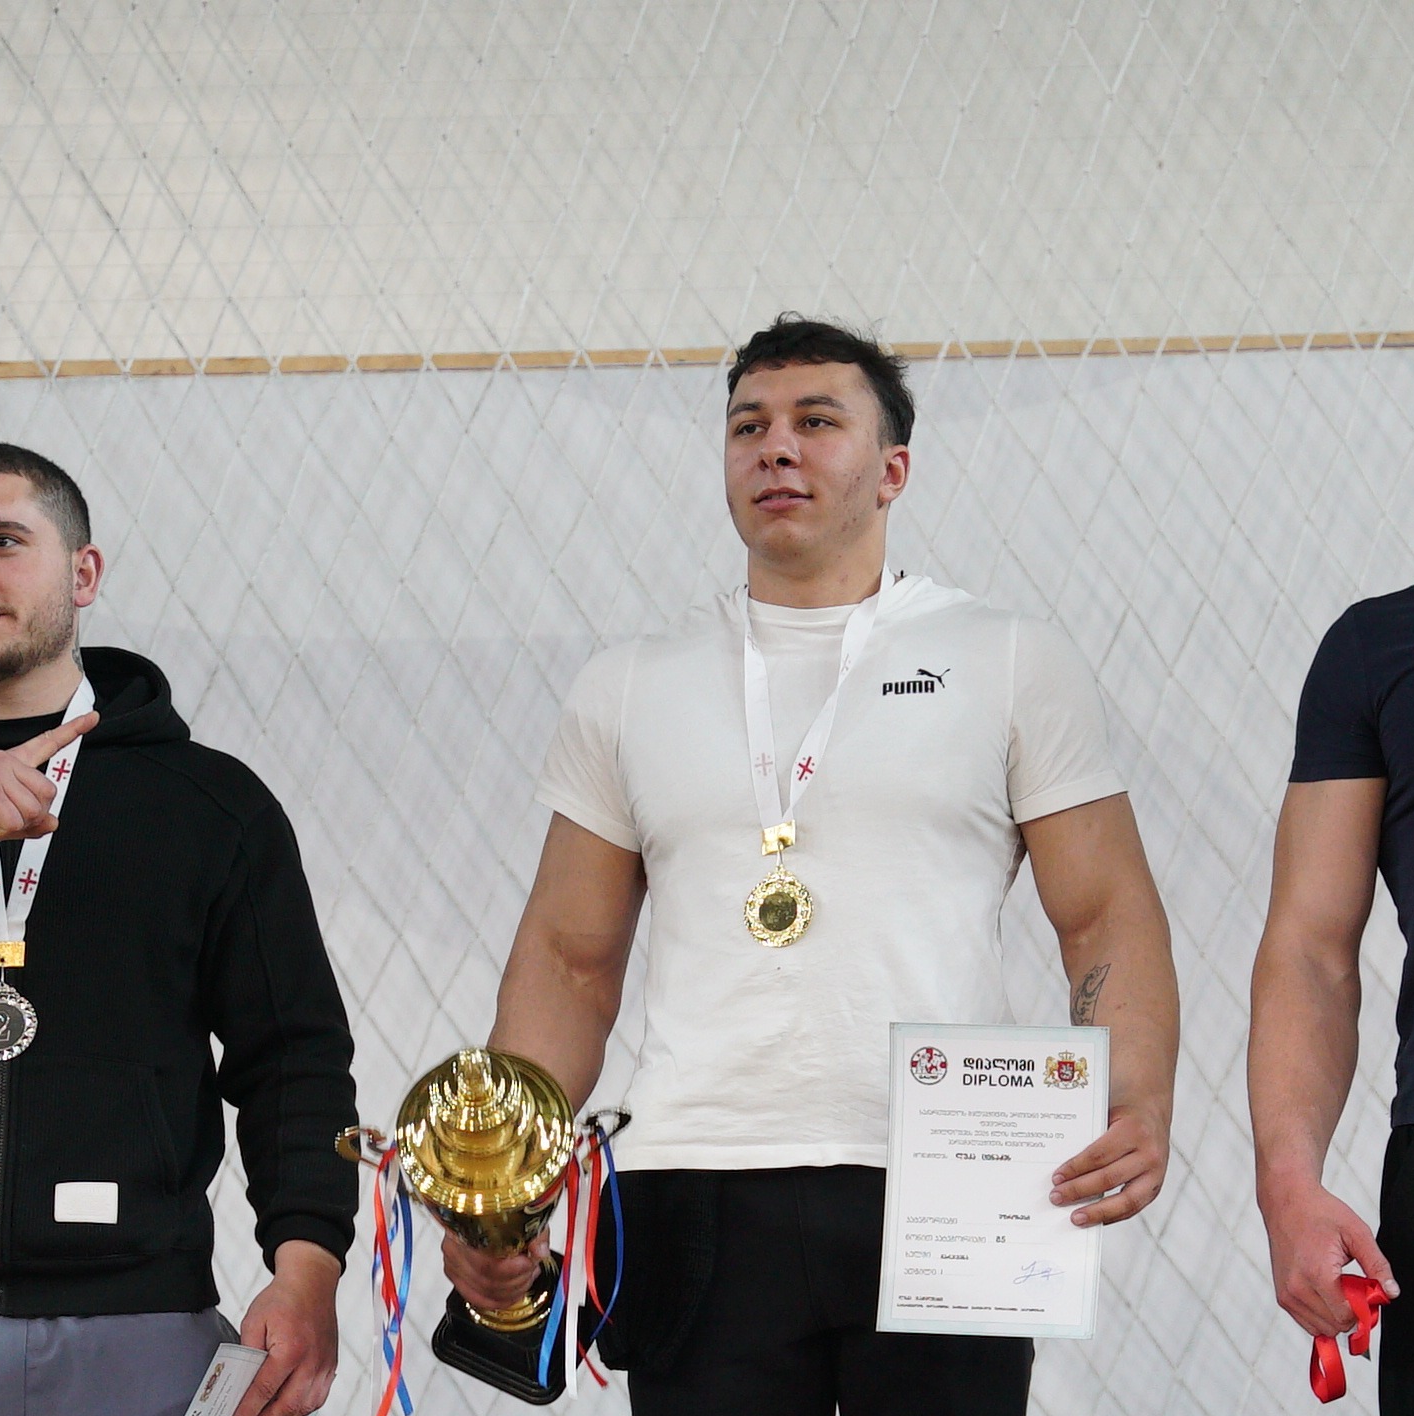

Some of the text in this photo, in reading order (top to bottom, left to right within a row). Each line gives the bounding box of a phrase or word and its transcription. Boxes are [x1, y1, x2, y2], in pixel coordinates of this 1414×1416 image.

[881, 680, 936, 697] PUMA
[962, 1056, 1035, 1073] დიპლომი
[962, 1073, 1035, 1088] DIPLOMA
